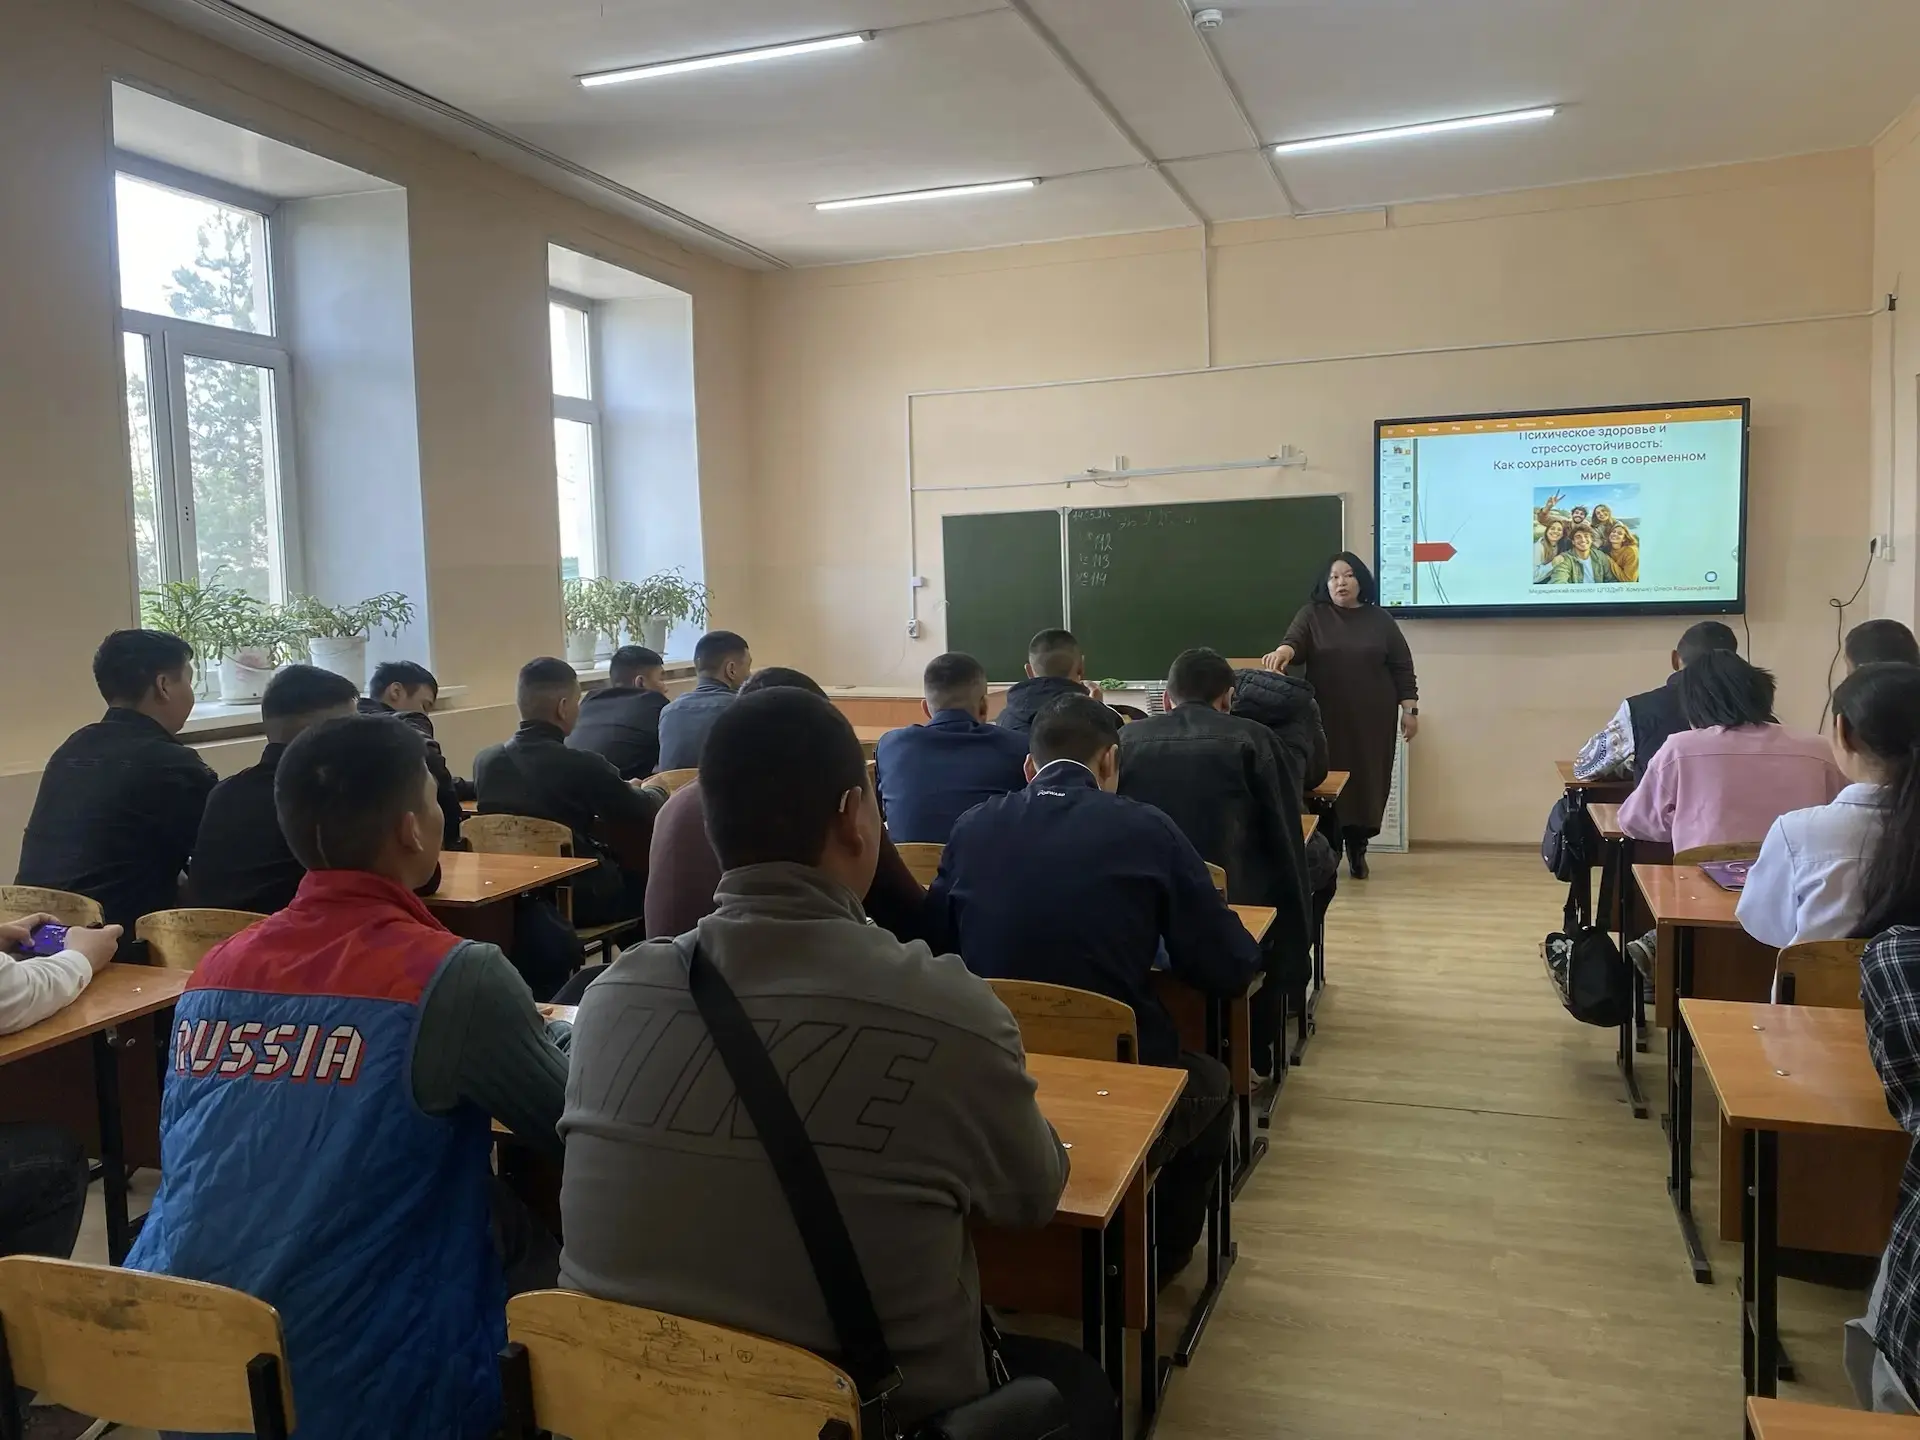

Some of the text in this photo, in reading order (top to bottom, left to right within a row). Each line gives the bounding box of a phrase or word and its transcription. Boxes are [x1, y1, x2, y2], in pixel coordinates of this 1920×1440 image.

[1519, 424, 1667, 441] Психическое здоровье и
[1531, 440, 1663, 456] стрессоустойчивость:
[1493, 452, 1706, 470] Как сохранить себя в современном
[1580, 471, 1612, 481] мире
[174, 1018, 367, 1086] RUSSIA
